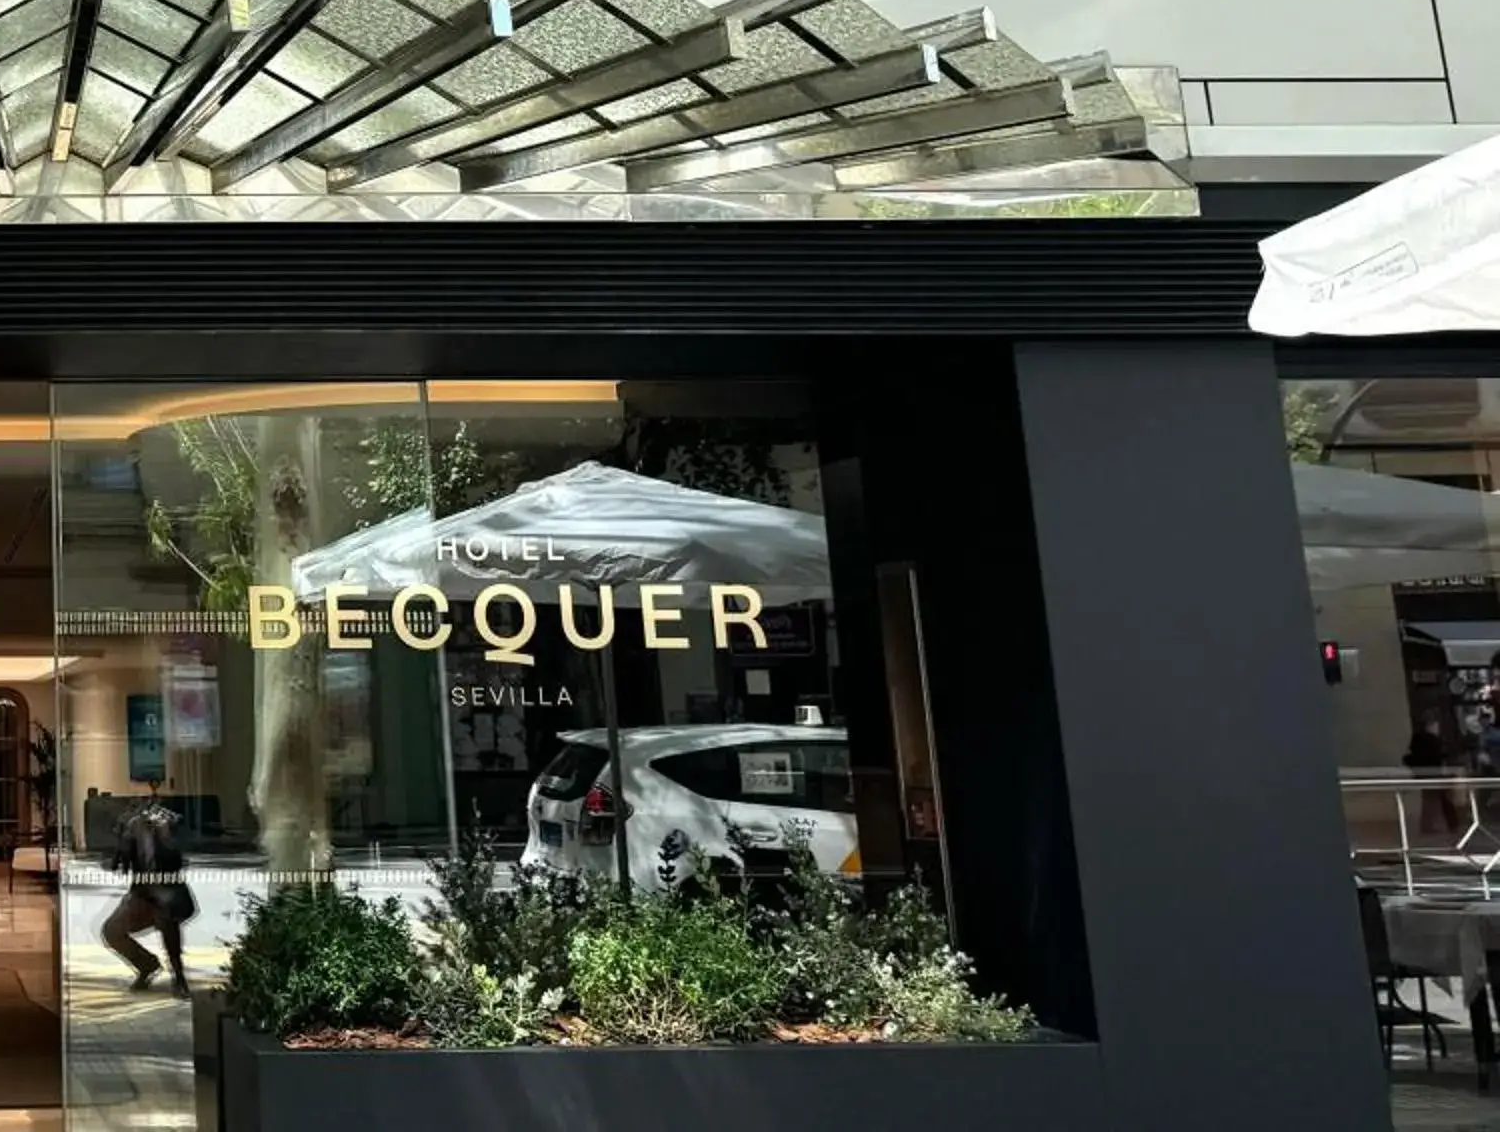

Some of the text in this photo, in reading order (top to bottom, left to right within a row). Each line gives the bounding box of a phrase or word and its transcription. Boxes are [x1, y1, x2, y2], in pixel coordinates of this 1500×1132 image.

[437, 536, 565, 561] HOTEL
[248, 583, 769, 666] BECQUER
[451, 686, 574, 708] SEVILLA
